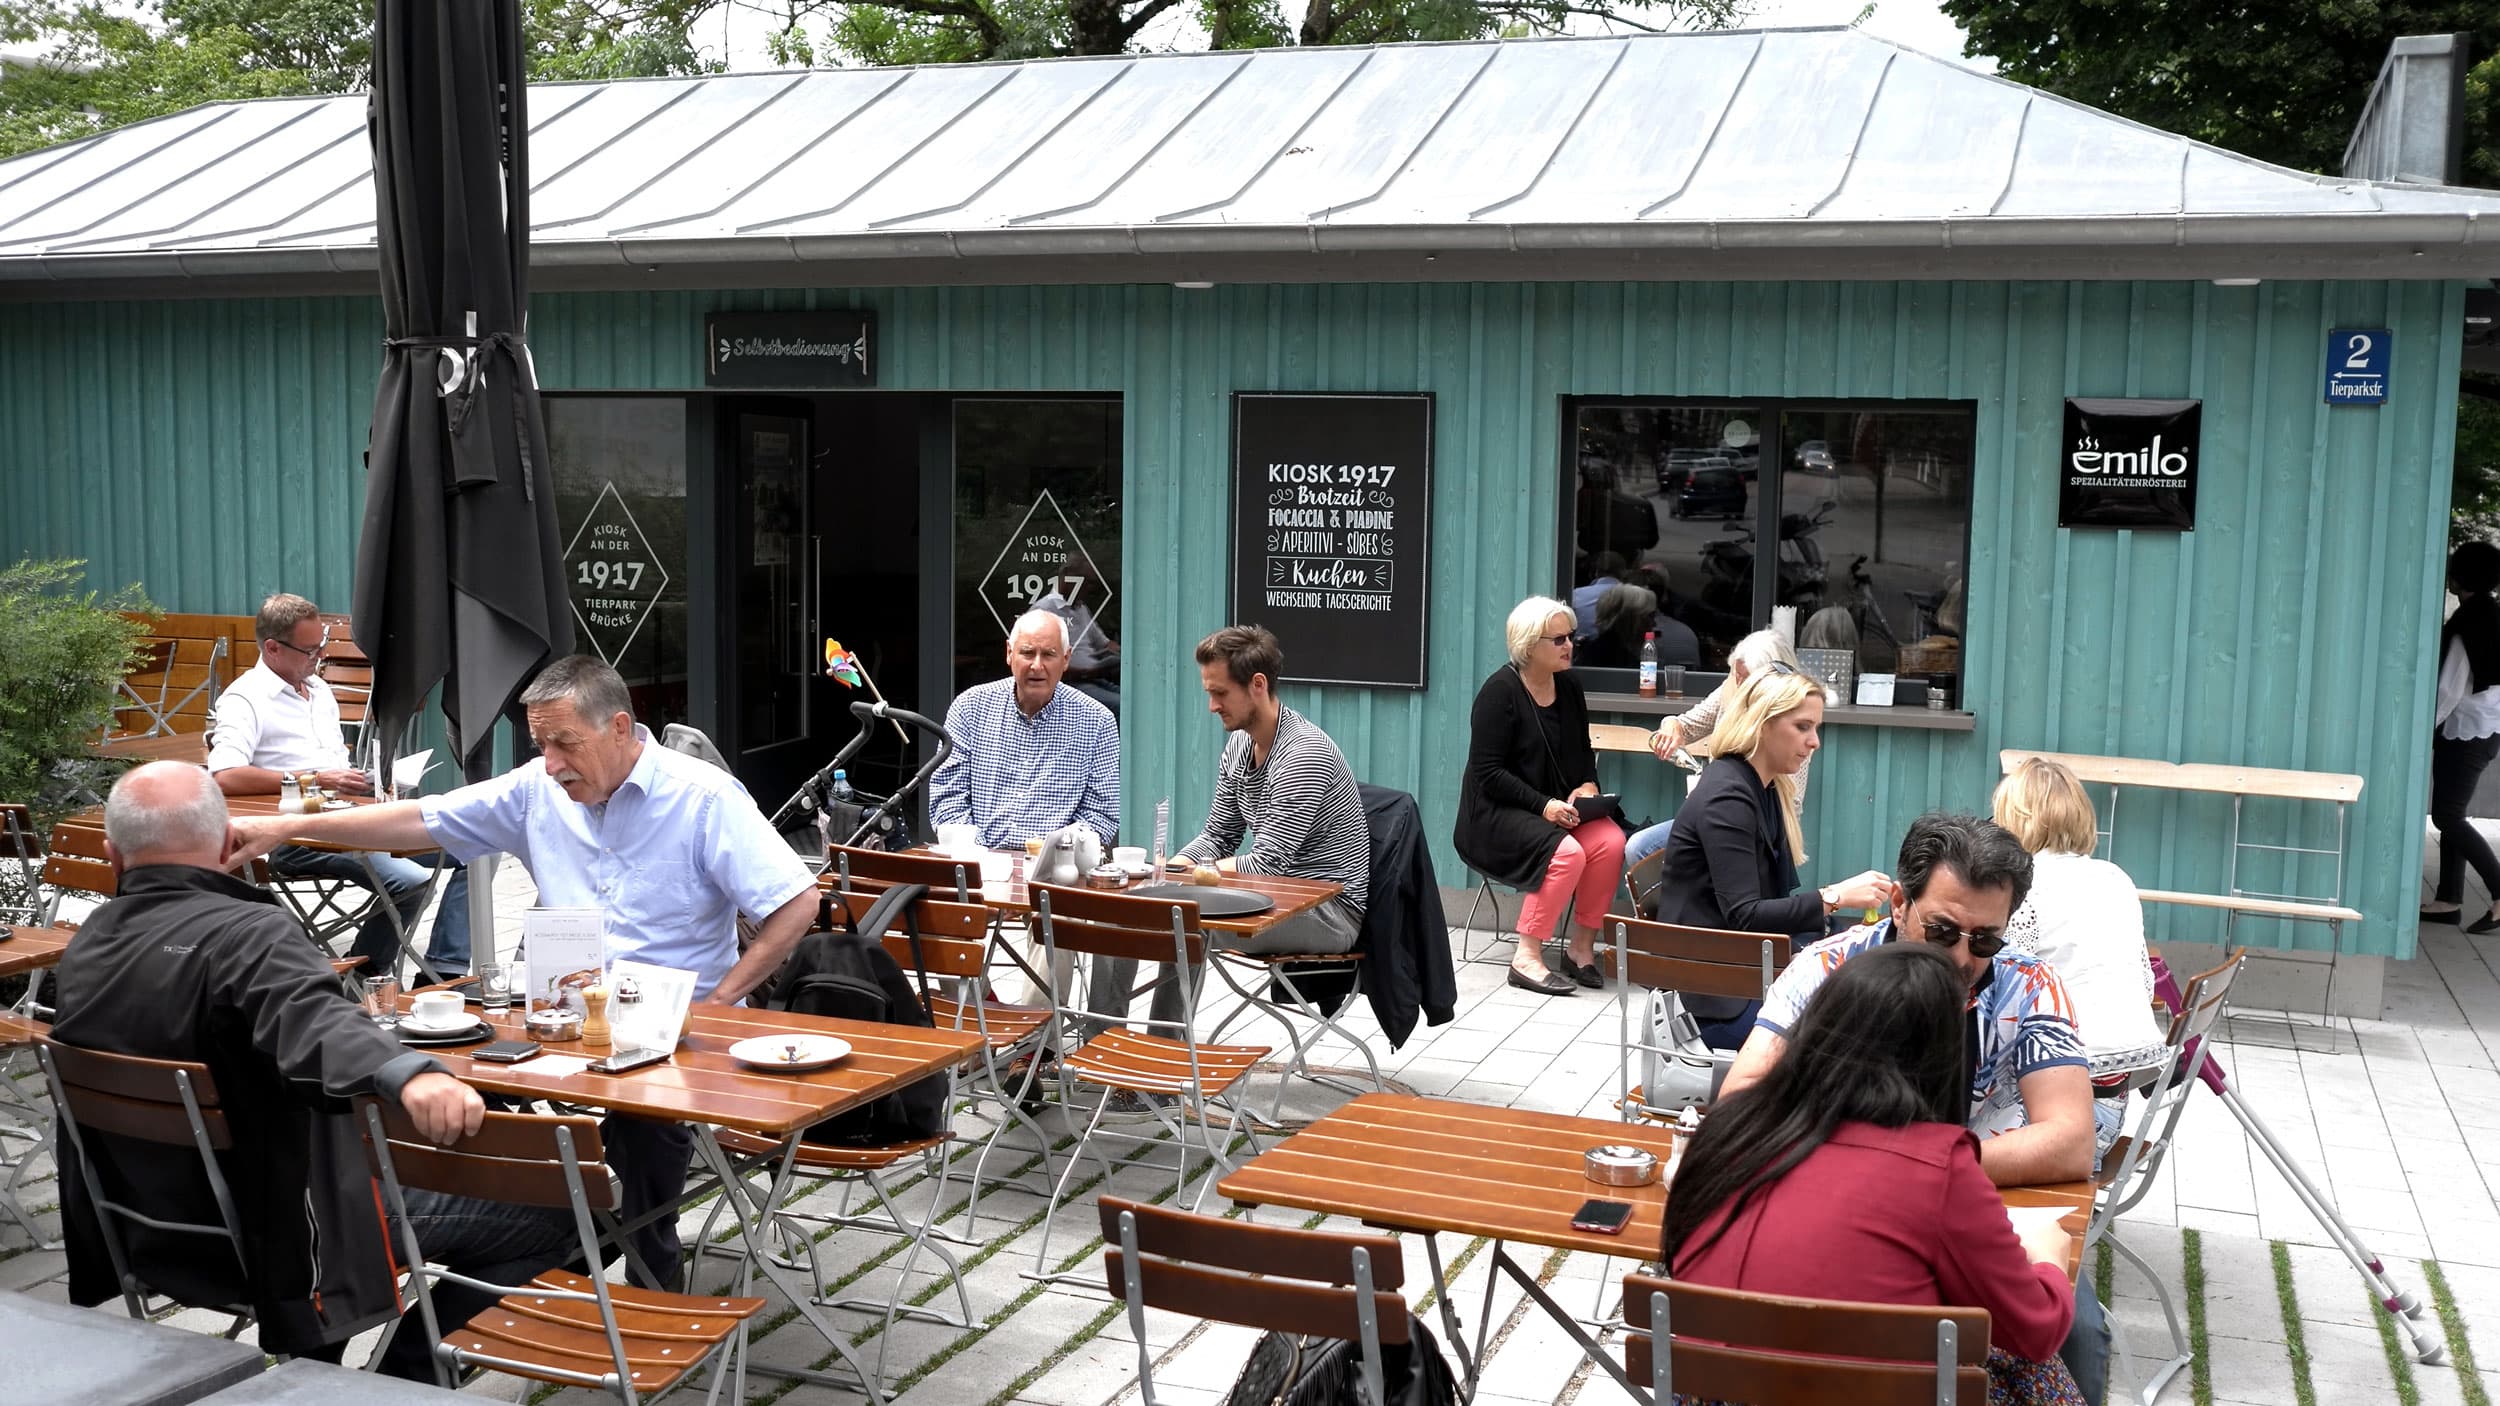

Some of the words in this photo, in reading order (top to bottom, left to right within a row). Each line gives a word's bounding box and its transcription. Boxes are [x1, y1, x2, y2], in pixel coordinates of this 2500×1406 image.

[733, 337, 851, 364] Selbstbedienung
[2346, 334, 2372, 368] 2
[2330, 380, 2383, 399] Tierparkstr.
[2072, 434, 2188, 476] emilo
[1268, 463, 1334, 483] KIOSK
[1338, 465, 1396, 488] 1917
[2071, 476, 2187, 489] SPEZIALITÄTENRÖSTEREI
[1298, 485, 1365, 507] Brotzeit
[1268, 508, 1324, 528] FOCACCIA
[1330, 510, 1341, 528] &
[1346, 510, 1394, 530] PIADINE
[593, 524, 628, 538] KIOSK
[590, 540, 604, 550] AN
[609, 540, 630, 551] DER
[1026, 535, 1065, 550] KIOSK
[1281, 531, 1333, 554] APERITIVI
[1022, 552, 1038, 563] AN
[1043, 552, 1067, 563] DER
[577, 560, 645, 590] 1917
[1292, 559, 1367, 589] Kuchen
[1007, 574, 1085, 607] 1917
[1266, 591, 1322, 609] WECHSELNDE
[1325, 592, 1392, 611] TAGESGERICHTE
[584, 598, 636, 610] TIERPARK
[590, 612, 633, 628] BRÜCKE
